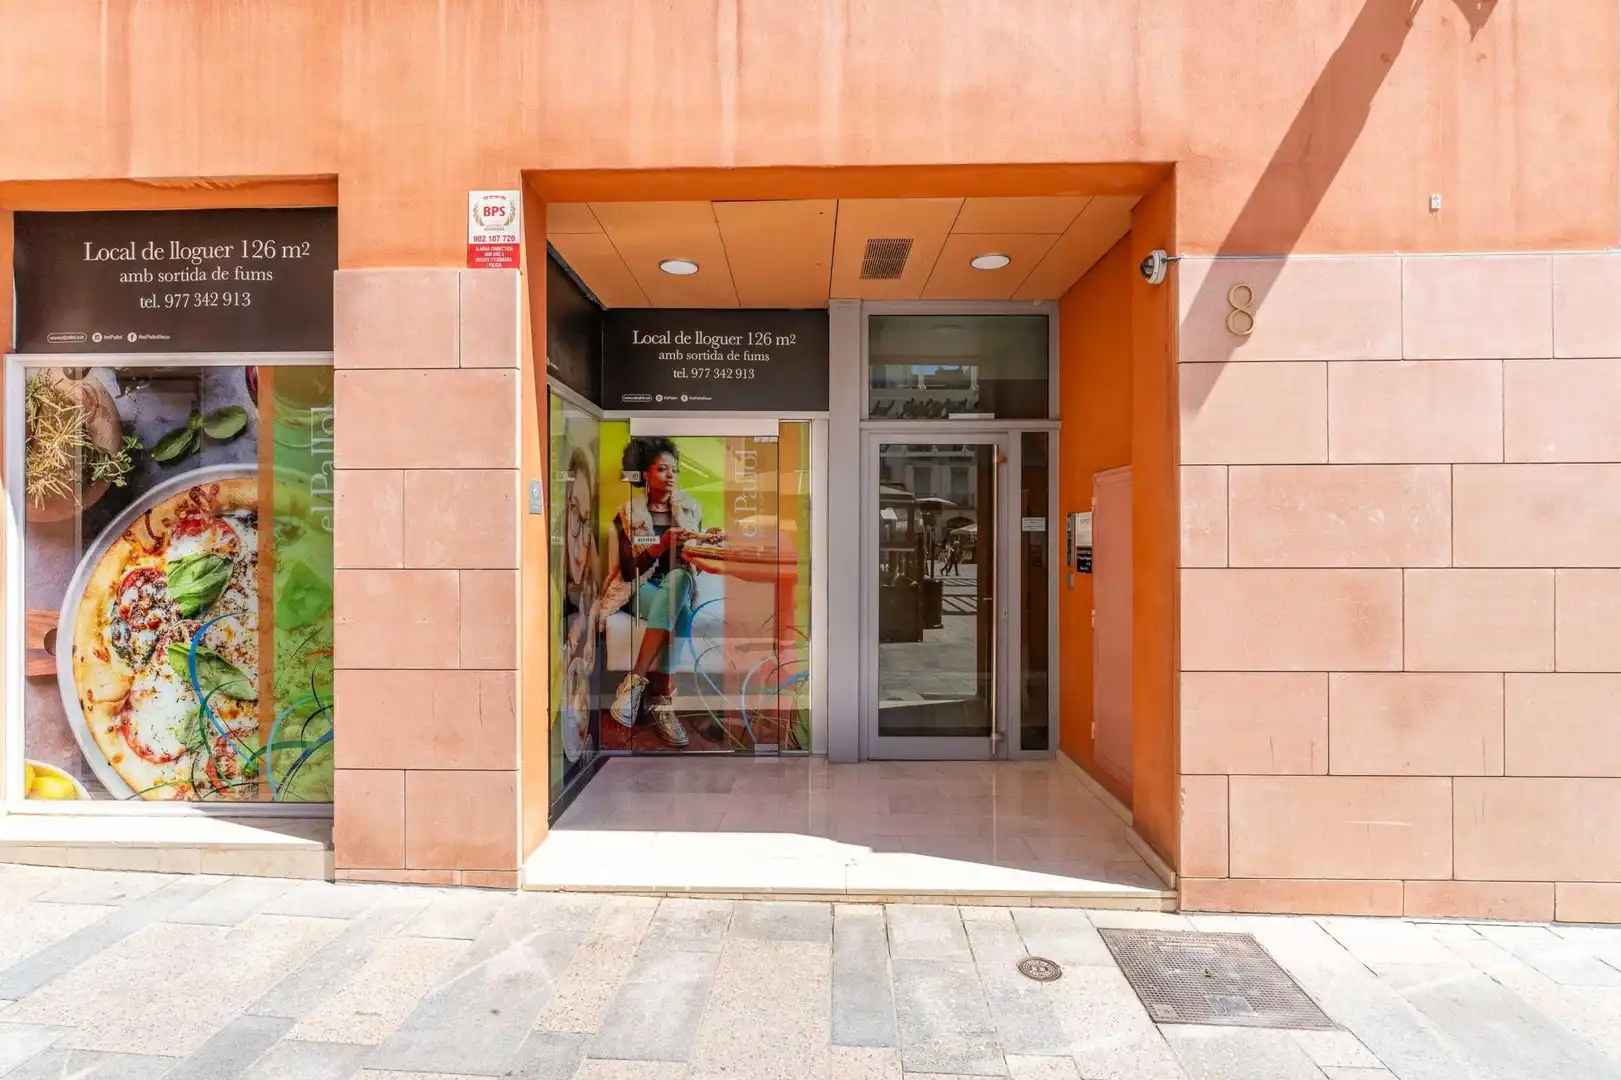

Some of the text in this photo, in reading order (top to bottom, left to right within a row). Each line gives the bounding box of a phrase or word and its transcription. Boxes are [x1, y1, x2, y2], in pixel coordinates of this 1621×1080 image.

[483, 206, 506, 217] BPS
[503, 234, 516, 242] 720
[83, 241, 136, 262] Local
[141, 241, 164, 261] de
[169, 240, 234, 265] lloguer
[241, 239, 276, 260] 126
[119, 265, 273, 283] amb sortida de fums
[139, 291, 251, 309] tel. 977 342 913
[1226, 283, 1255, 336] 8
[632, 330, 671, 345] Local
[674, 330, 692, 345] de
[695, 330, 743, 349] lloguer
[747, 331, 772, 346] 126
[658, 349, 770, 362] amb sortida de fums
[673, 367, 755, 380] tel. 977 342 913
